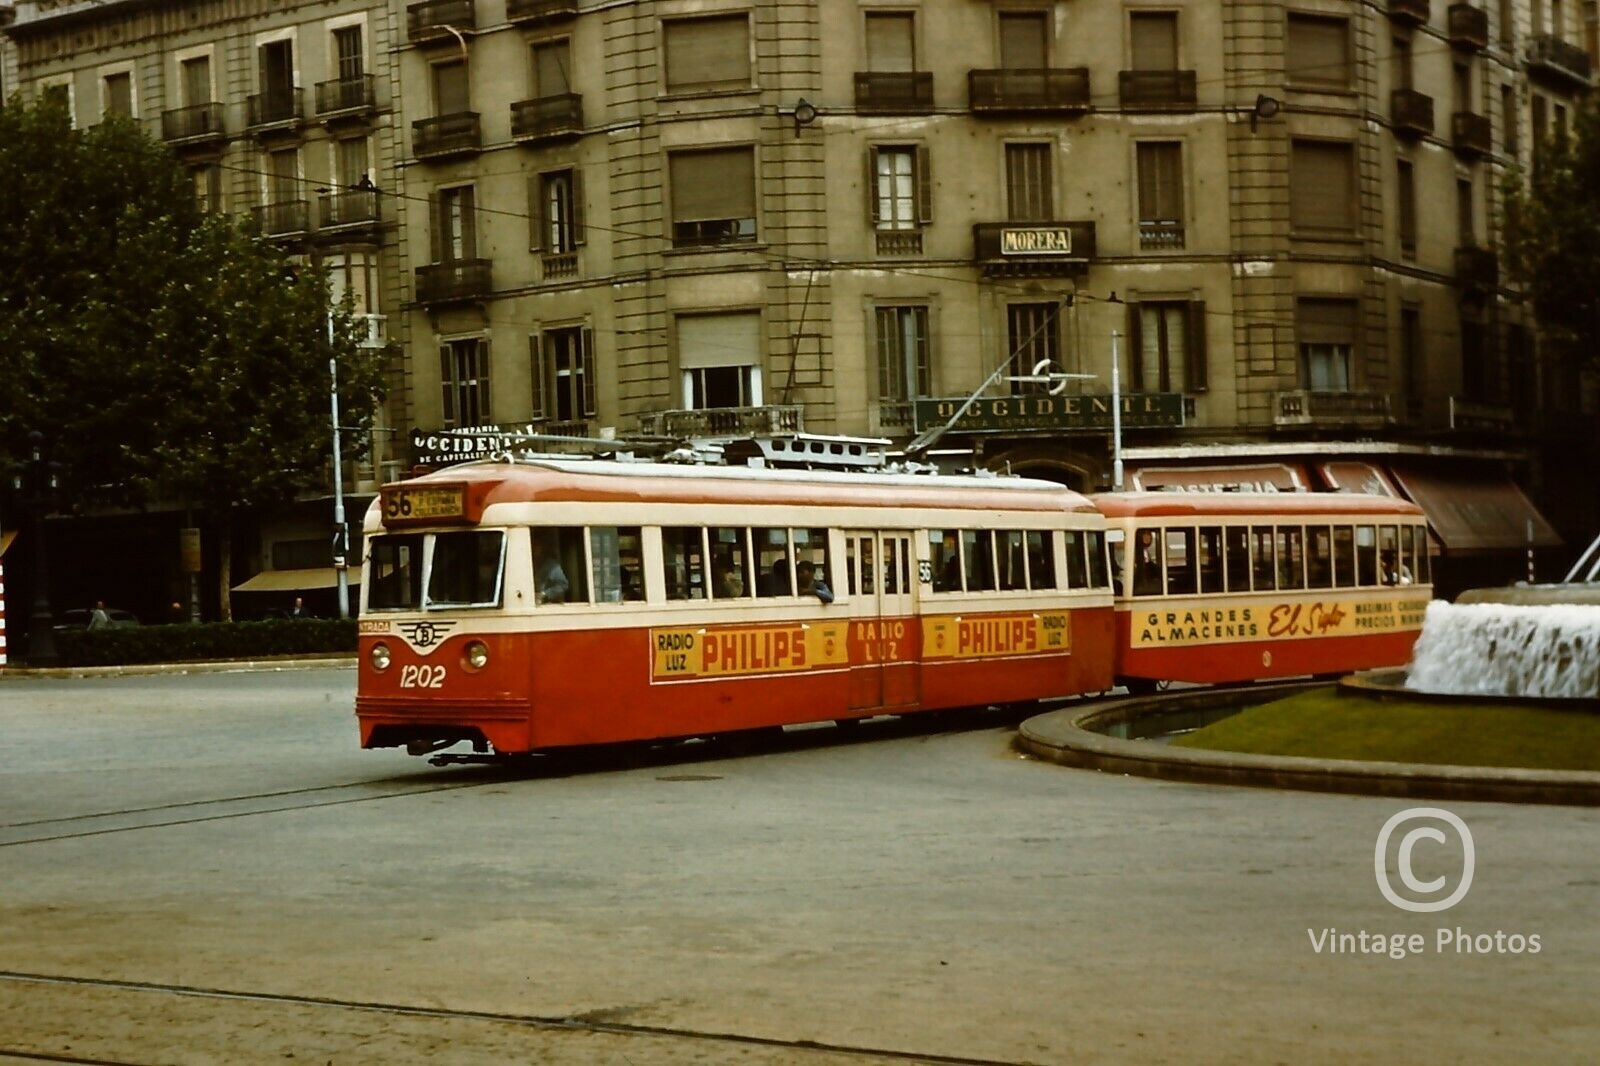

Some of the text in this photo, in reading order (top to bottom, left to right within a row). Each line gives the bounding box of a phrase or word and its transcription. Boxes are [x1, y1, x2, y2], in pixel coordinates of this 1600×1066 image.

[1005, 231, 1068, 250] MORERA
[938, 396, 1159, 417] OCCIDENTE
[387, 489, 412, 517] 56
[919, 561, 932, 583] 56
[1043, 615, 1066, 629] RADIO
[1148, 609, 1251, 626] GRANDES
[1267, 603, 1302, 637] El
[857, 622, 905, 641] RADIO
[959, 619, 1037, 654] PHILIPS
[1141, 623, 1257, 641] ALMACENES
[658, 633, 694, 651] RADIO
[702, 631, 806, 672] PHILIPS
[665, 654, 687, 671] LUZ
[400, 665, 446, 688] 1202
